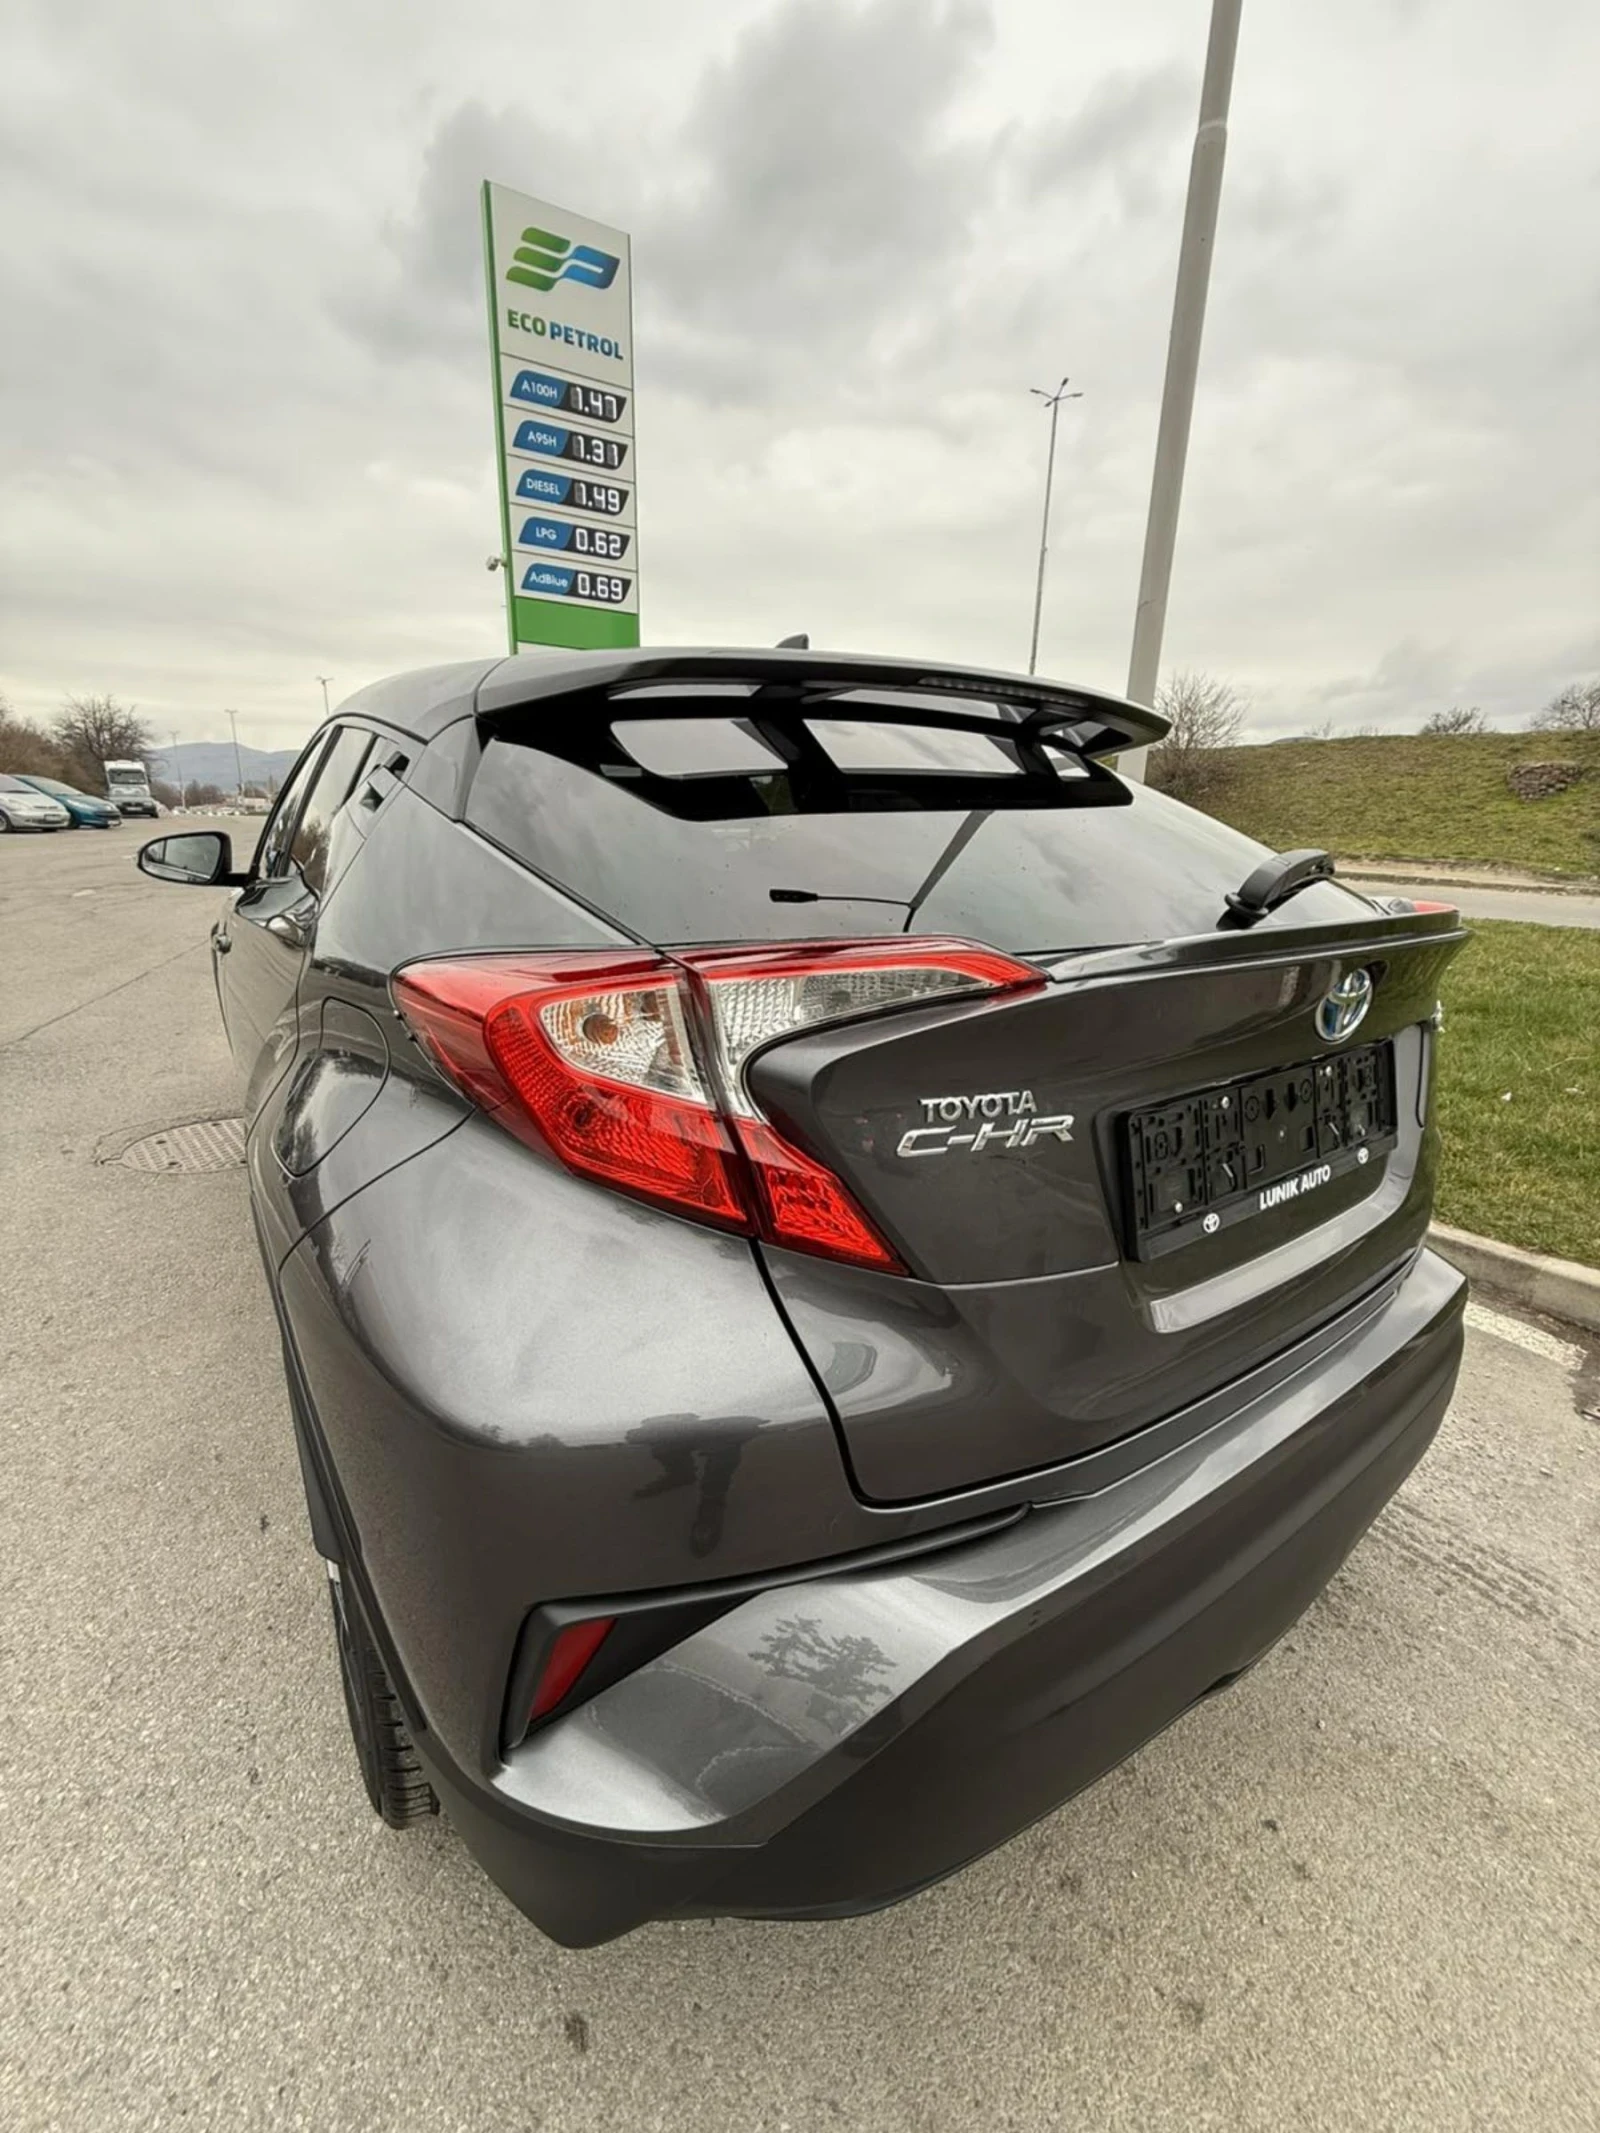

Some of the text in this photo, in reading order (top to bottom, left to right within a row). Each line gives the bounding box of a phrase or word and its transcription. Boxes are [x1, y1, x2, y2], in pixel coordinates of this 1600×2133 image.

[507, 308, 624, 361] ECO PETROL
[521, 379, 558, 399] A100H
[527, 430, 557, 447] A95H
[526, 478, 620, 512] DIESEL 1.49
[535, 526, 621, 557] LPG 0.62
[529, 571, 623, 601] AdBlue 0.69
[920, 1090, 1037, 1122] TOYOTA
[897, 1115, 1074, 1157] C-HR
[1259, 1164, 1331, 1210] LUNIK AUTO
